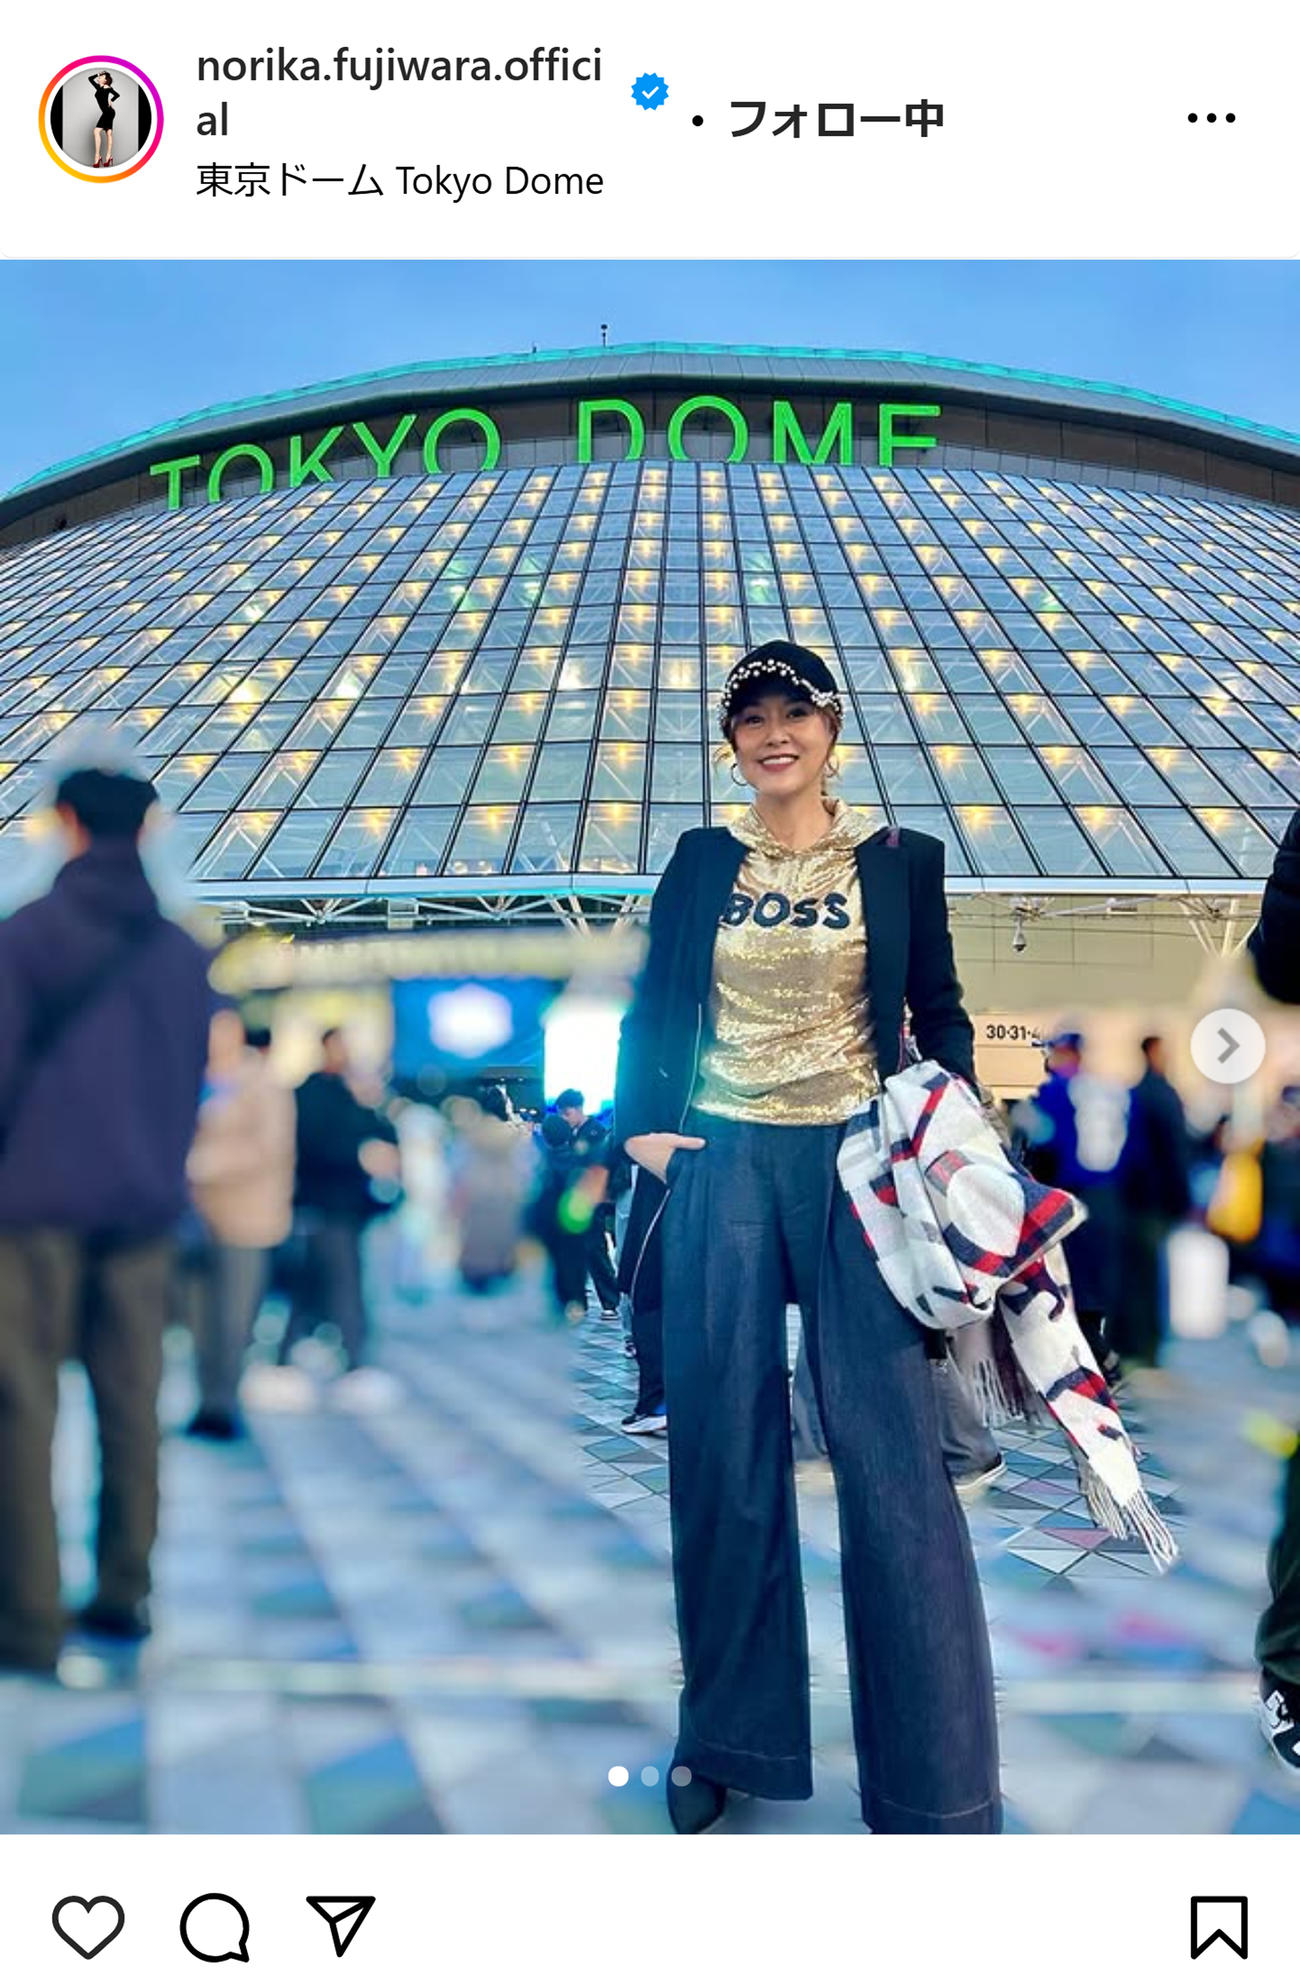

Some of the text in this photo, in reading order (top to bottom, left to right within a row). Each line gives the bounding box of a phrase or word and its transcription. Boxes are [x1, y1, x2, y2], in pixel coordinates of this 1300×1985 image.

[150, 395, 941, 509] TOKYO DOME
[719, 892, 851, 930] BOSS
